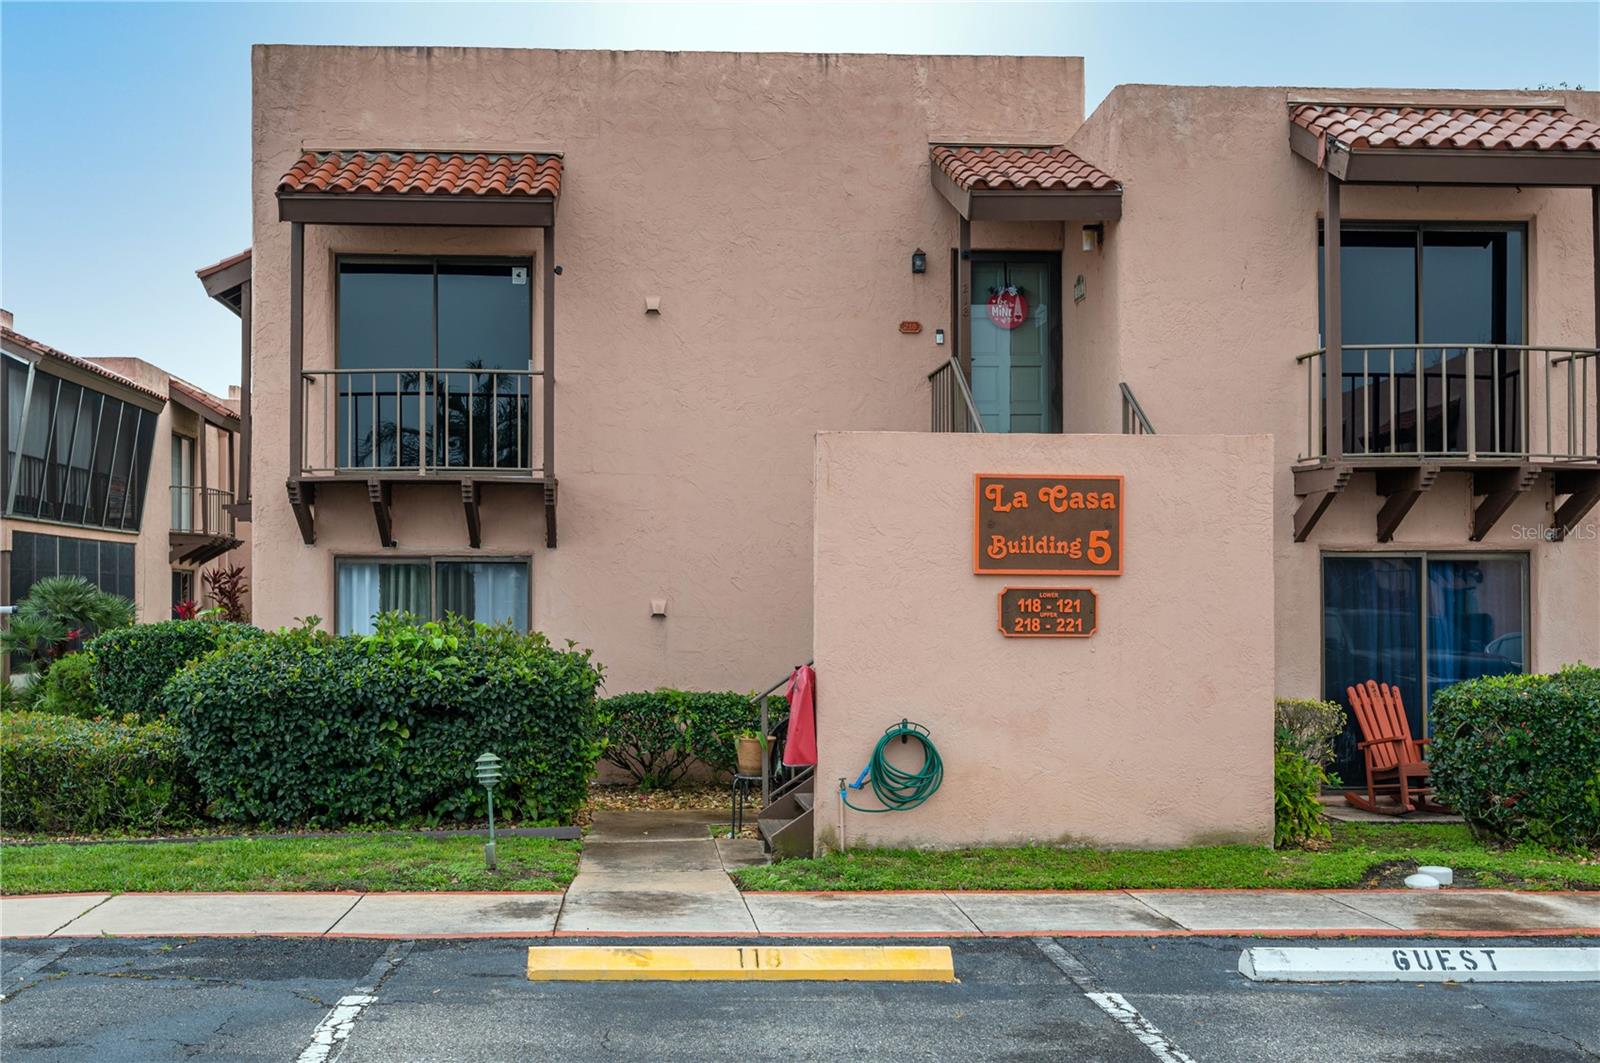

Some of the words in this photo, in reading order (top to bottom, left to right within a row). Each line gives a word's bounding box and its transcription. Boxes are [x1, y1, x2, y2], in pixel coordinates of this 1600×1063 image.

[985, 484, 1028, 512] La
[1038, 484, 1116, 513] Casa
[986, 535, 1083, 559] Building
[1087, 530, 1112, 565] 5
[1017, 598, 1041, 613] 118
[1056, 598, 1081, 613] 121
[1014, 618, 1040, 632] 218
[1056, 618, 1083, 632] 221
[1392, 950, 1497, 971] GUEST
